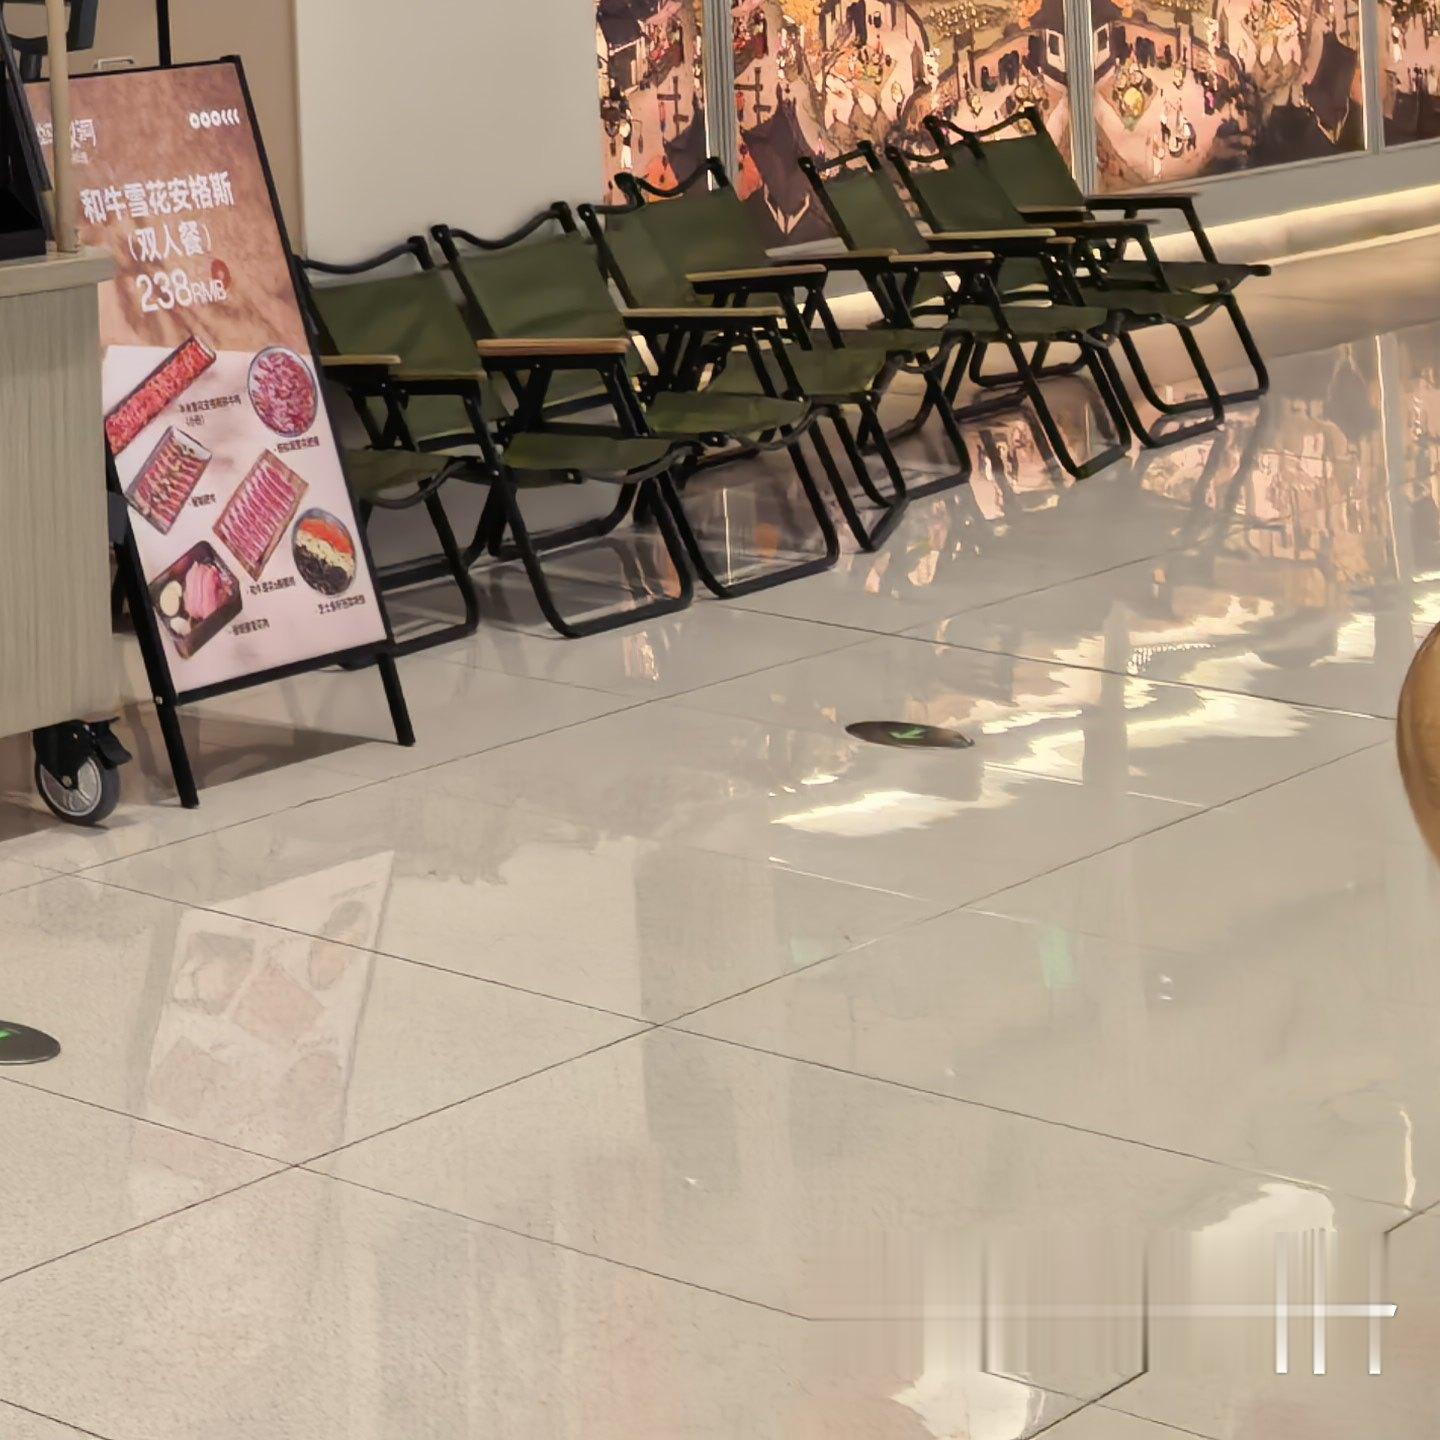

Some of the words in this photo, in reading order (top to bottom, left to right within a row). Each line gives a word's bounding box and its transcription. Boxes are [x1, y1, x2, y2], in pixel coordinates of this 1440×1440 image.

[79, 171, 235, 226] 和牛雪花安格斯
